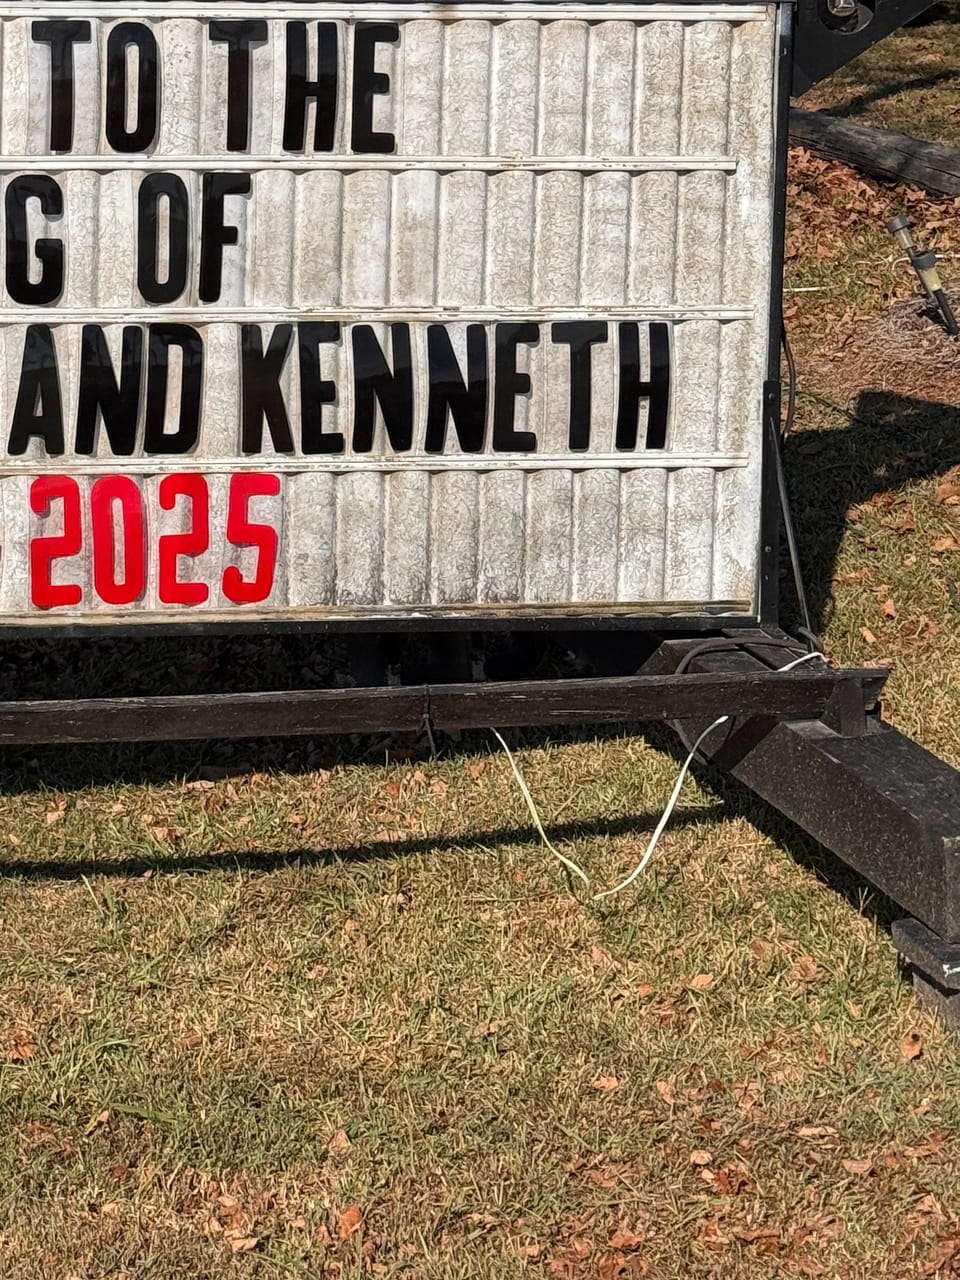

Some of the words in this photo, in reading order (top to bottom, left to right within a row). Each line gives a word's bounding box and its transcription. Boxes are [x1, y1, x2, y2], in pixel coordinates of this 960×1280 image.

[32, 19, 158, 154] TO
[209, 19, 400, 154] THE
[138, 172, 252, 305] OF
[8, 322, 204, 456] AND
[241, 320, 670, 455] KENNETH
